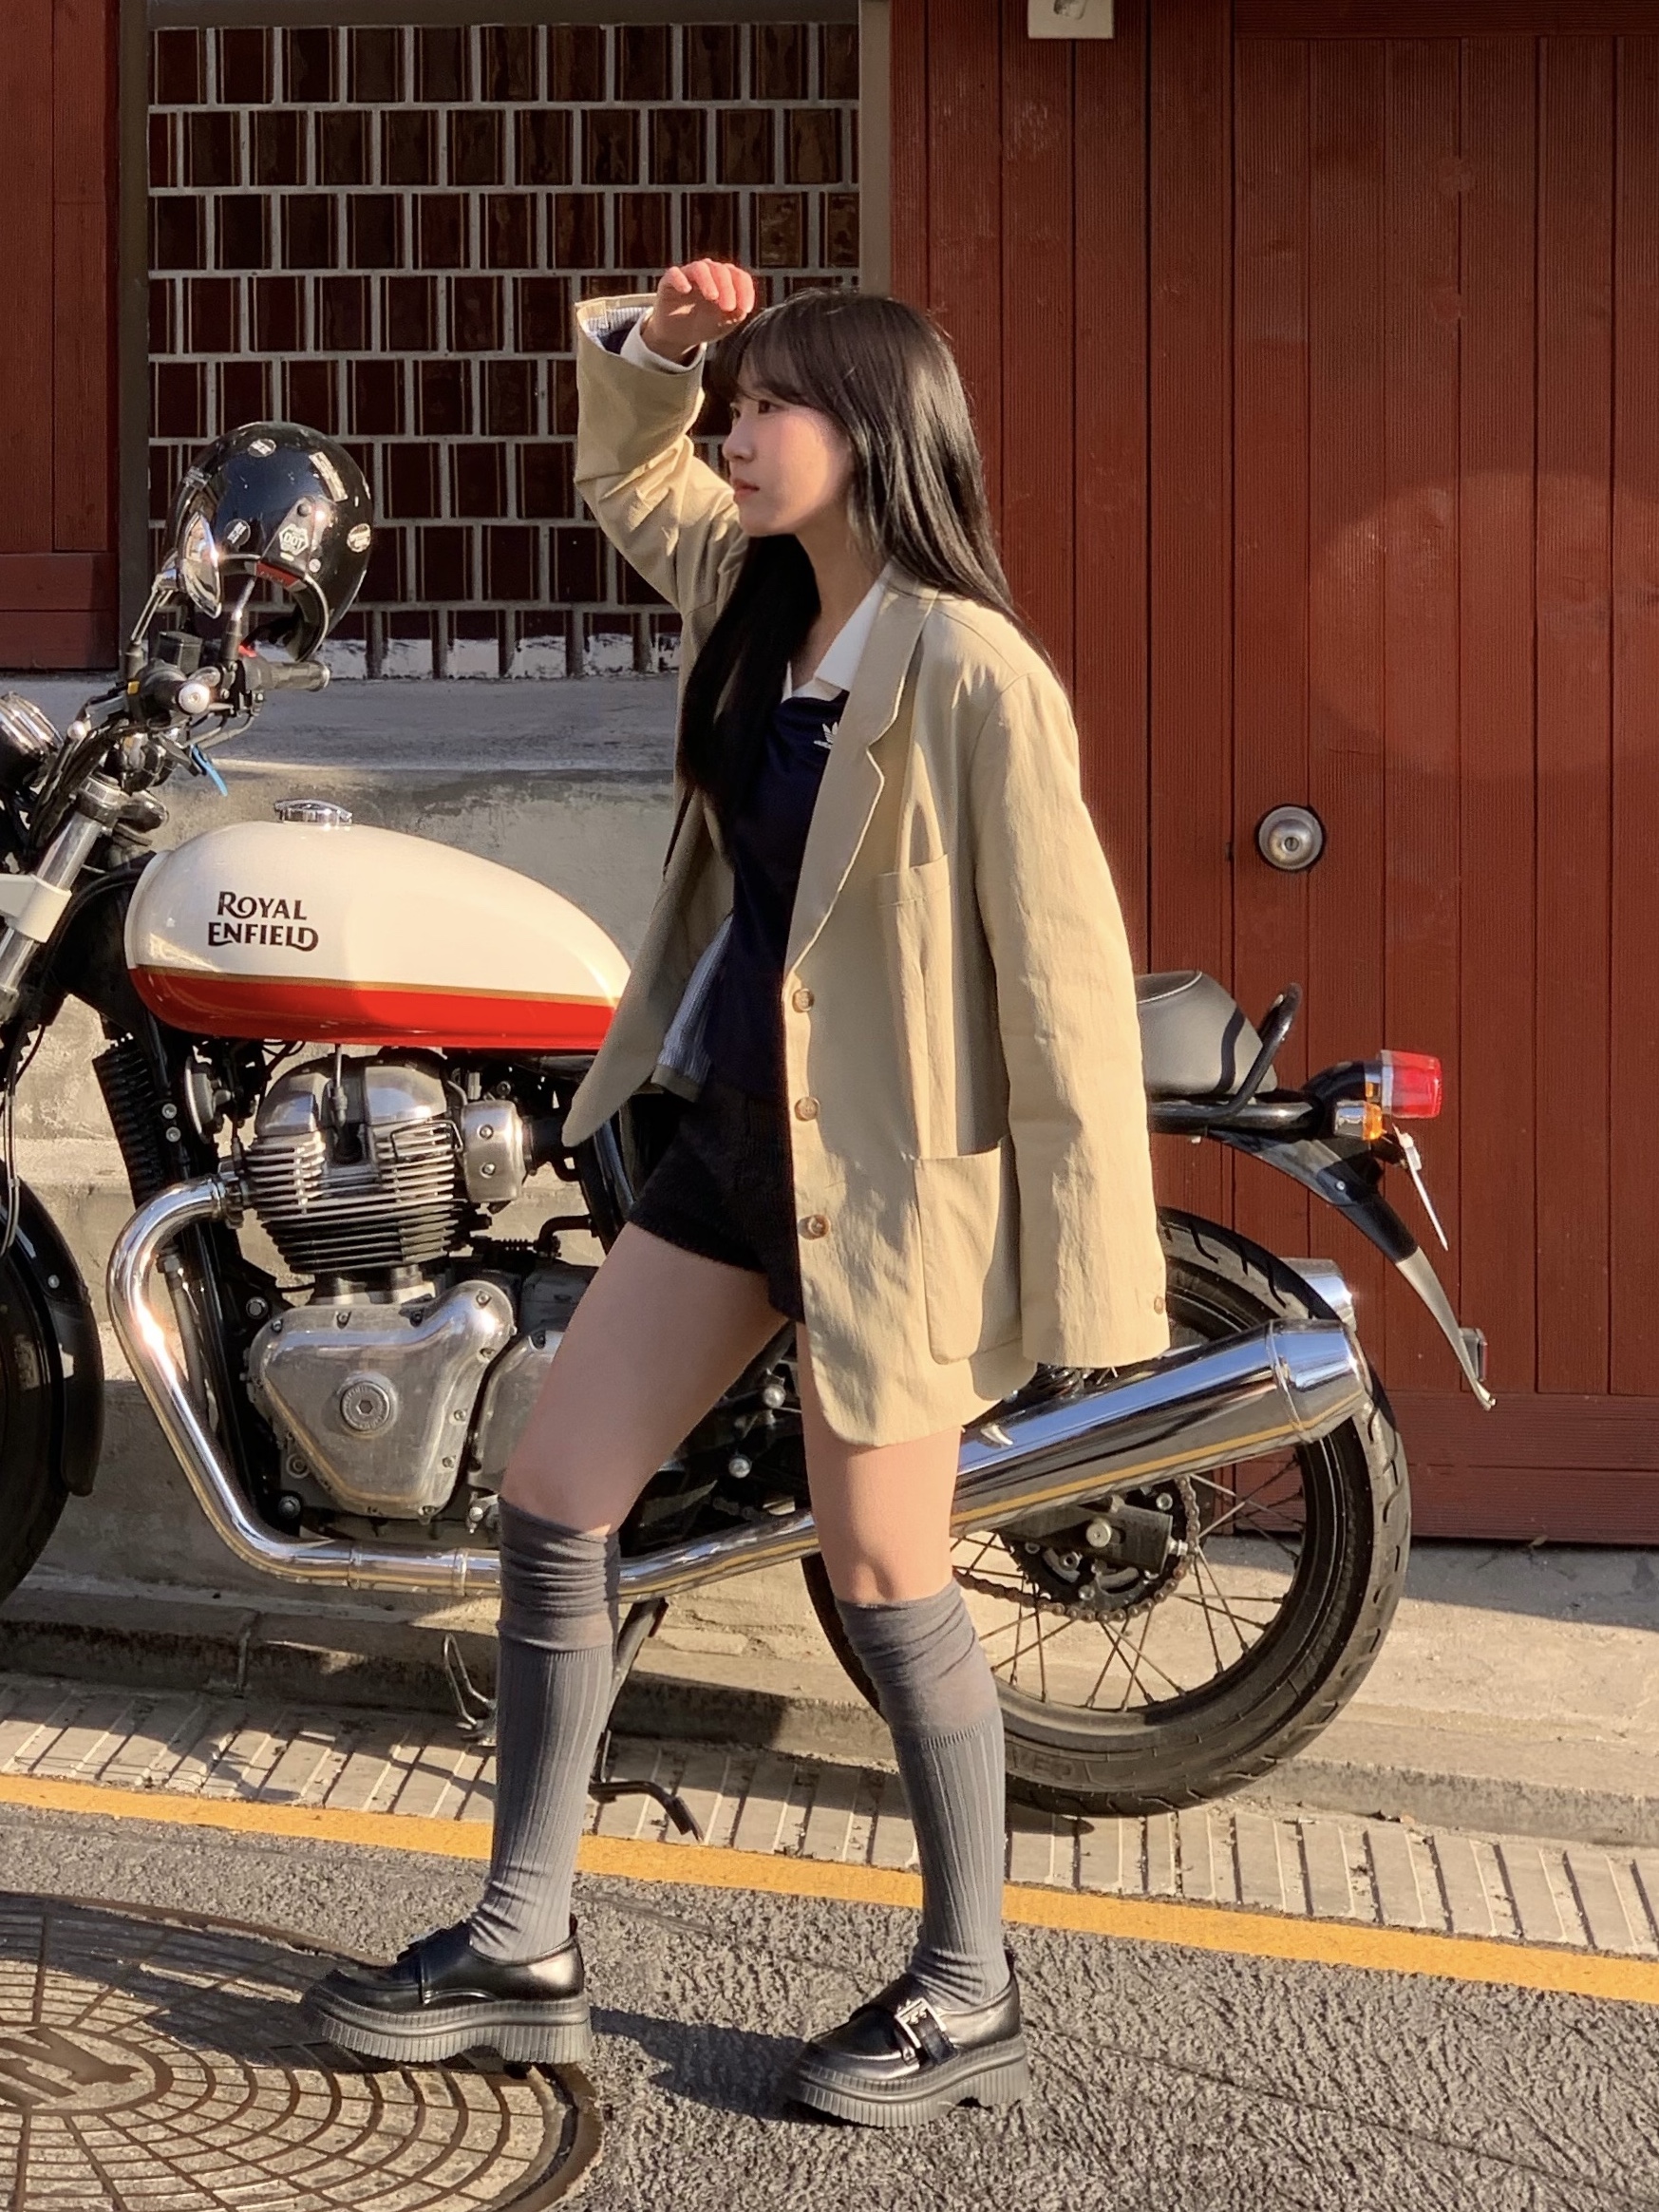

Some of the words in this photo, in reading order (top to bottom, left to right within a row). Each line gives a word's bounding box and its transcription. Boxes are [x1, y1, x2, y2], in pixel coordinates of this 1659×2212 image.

[283, 532, 306, 550] DOT
[217, 891, 308, 920] ROYAL
[208, 921, 319, 952] ENFIELD
